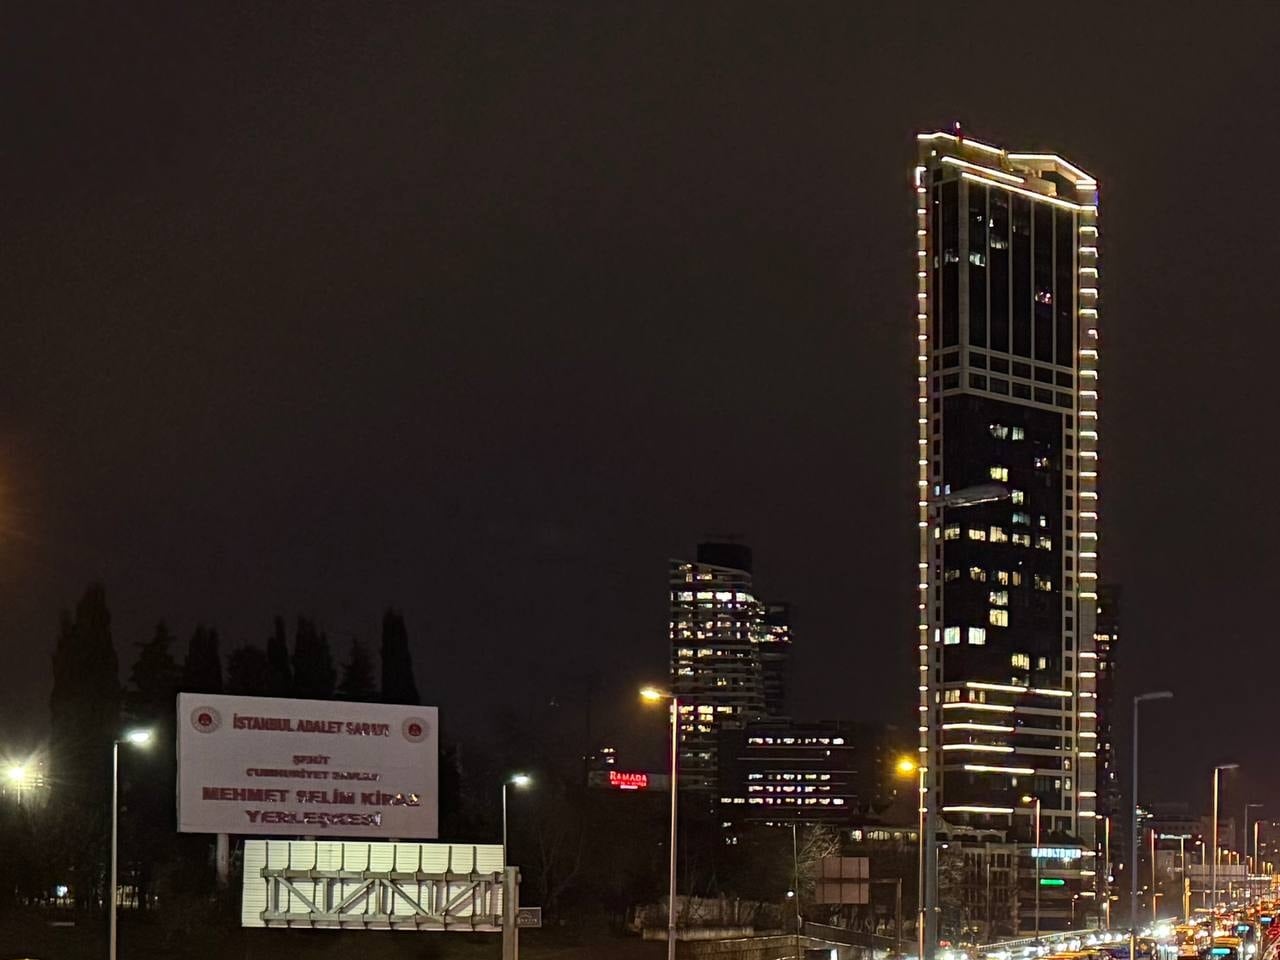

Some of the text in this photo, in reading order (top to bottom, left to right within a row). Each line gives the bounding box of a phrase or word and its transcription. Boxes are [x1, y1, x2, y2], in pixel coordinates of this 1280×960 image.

[233, 713, 294, 732] İSTANBUL
[294, 719, 343, 735] ADALET
[202, 787, 289, 803] MEHMET
[296, 788, 355, 805] SELİM
